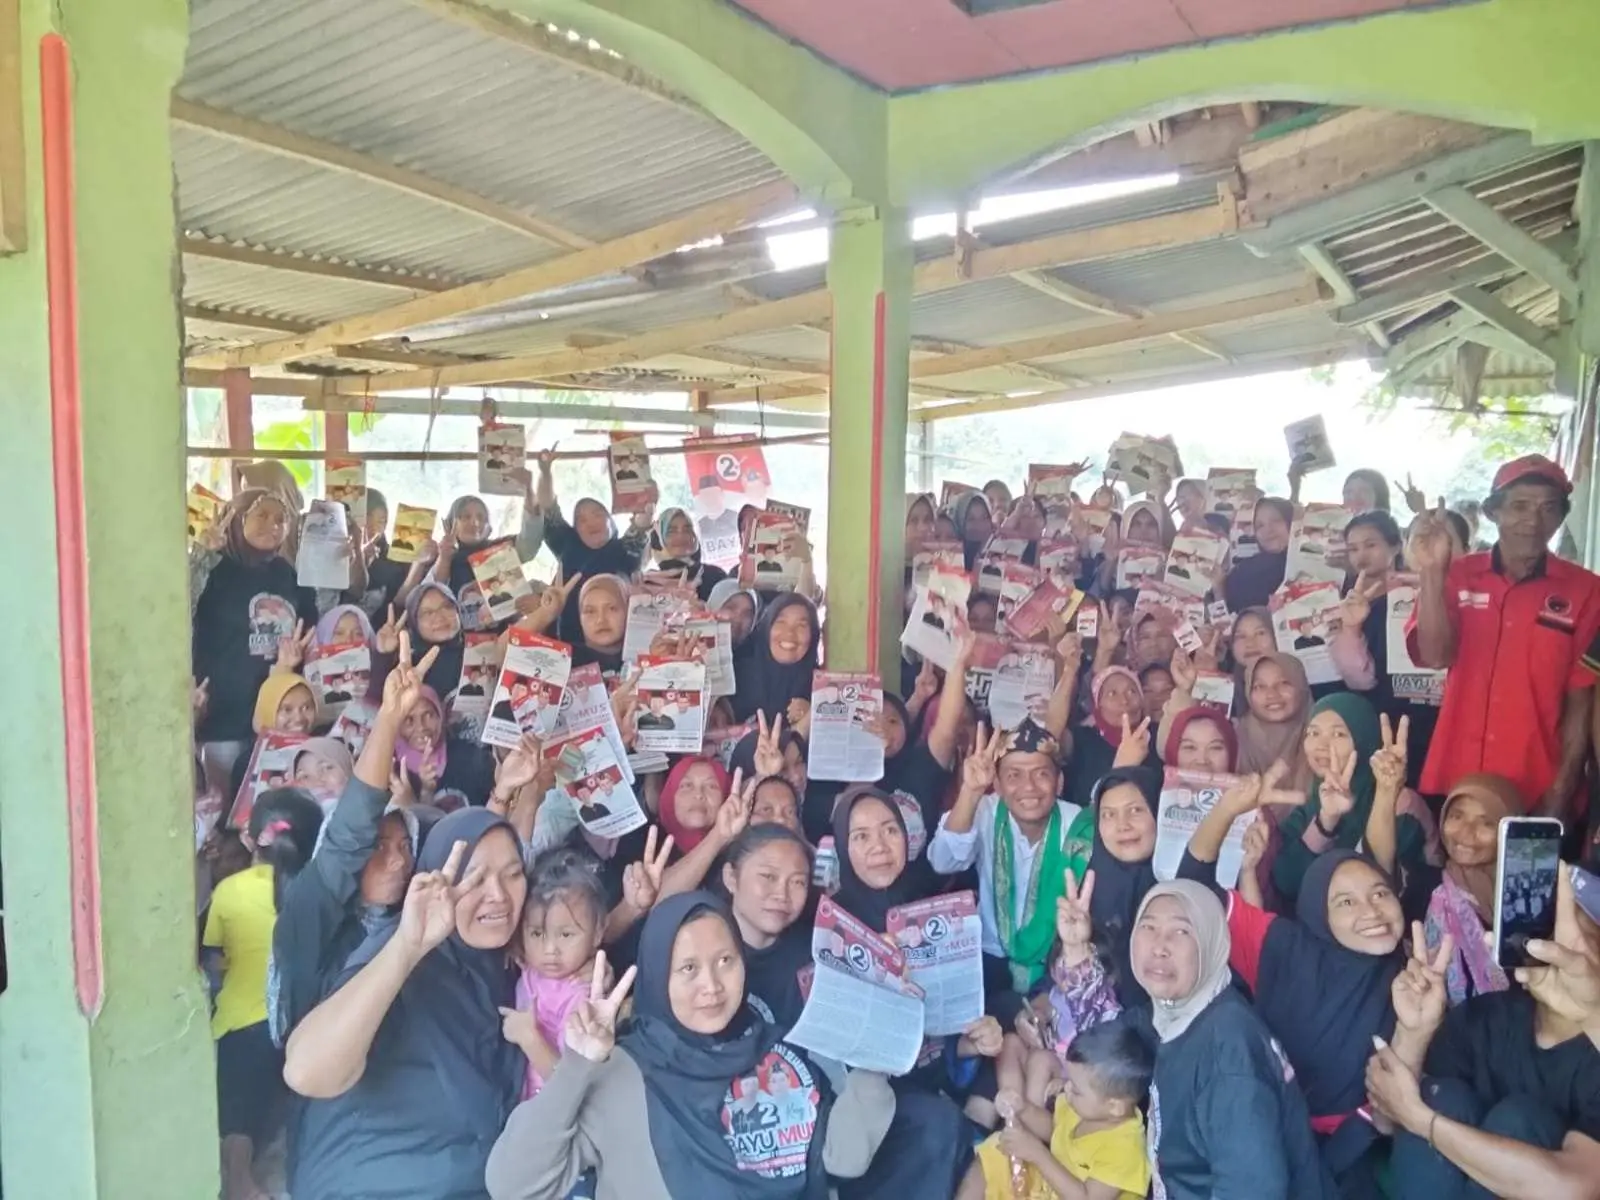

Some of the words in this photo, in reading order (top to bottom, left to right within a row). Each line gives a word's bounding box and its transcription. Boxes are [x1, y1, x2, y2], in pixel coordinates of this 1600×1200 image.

[719, 456, 738, 478] 2
[706, 535, 738, 552] BAY
[534, 667, 542, 677] 2
[667, 681, 675, 689] 2
[845, 686, 856, 699] 2
[1201, 790, 1215, 806] 2
[927, 919, 943, 937] 2
[852, 945, 865, 968] 2
[758, 1103, 780, 1126] 2
[777, 1120, 815, 1147] MU
